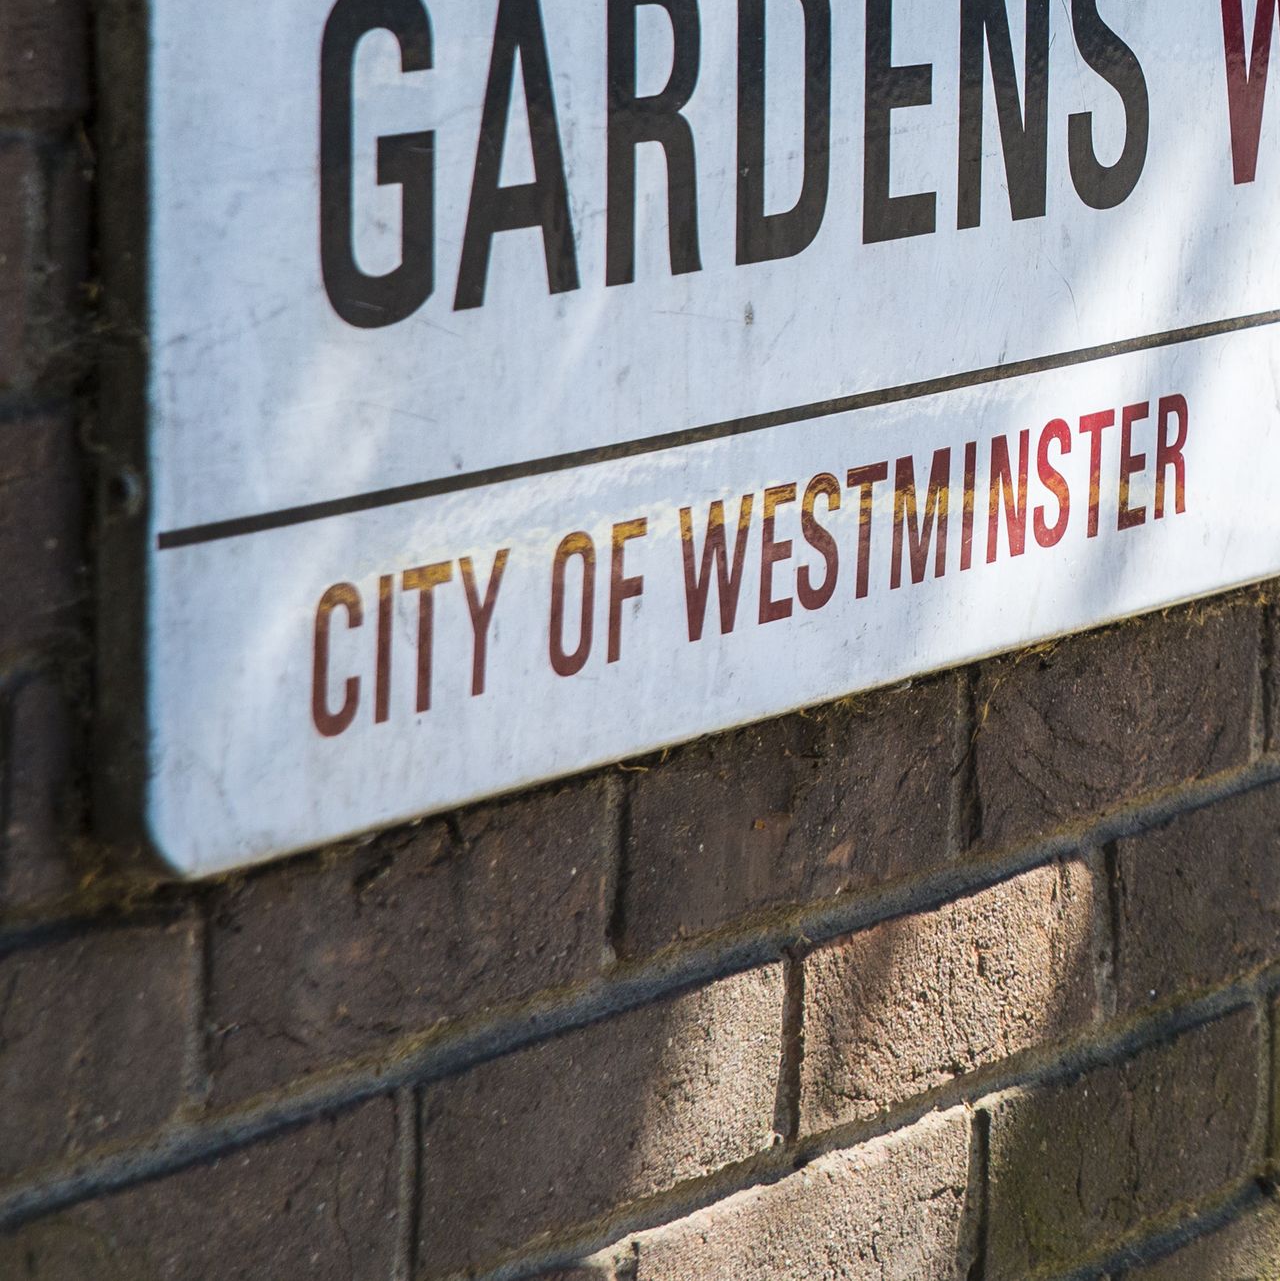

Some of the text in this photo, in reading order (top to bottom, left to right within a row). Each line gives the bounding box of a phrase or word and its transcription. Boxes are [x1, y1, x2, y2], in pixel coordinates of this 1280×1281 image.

[310, 393, 1190, 739] CITY OF WESTMINSTER
